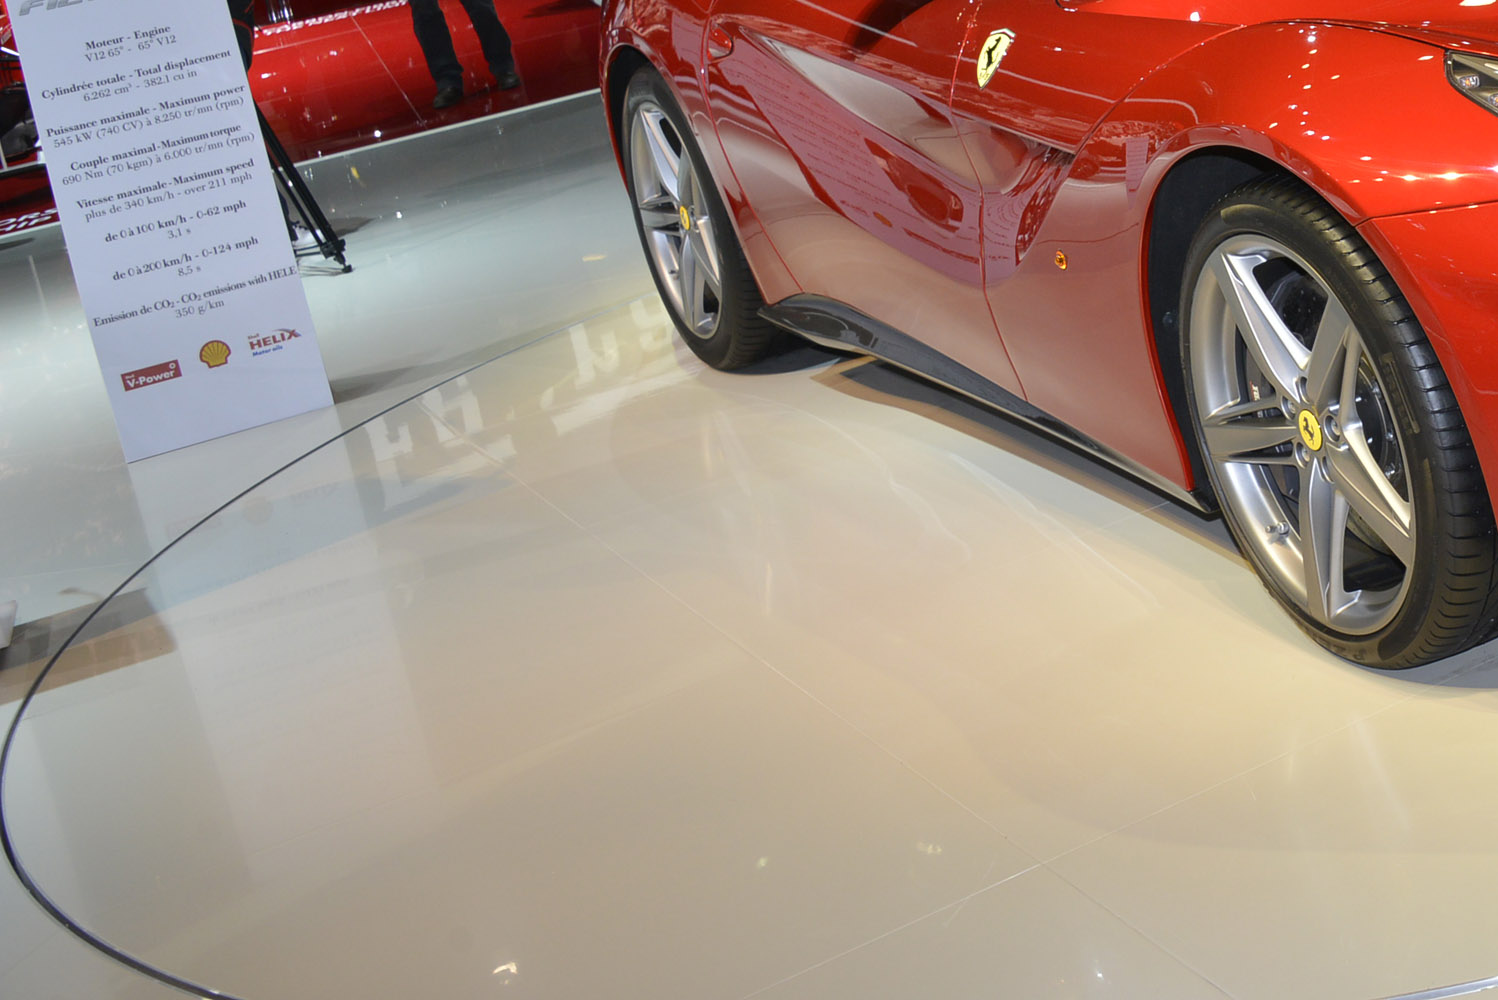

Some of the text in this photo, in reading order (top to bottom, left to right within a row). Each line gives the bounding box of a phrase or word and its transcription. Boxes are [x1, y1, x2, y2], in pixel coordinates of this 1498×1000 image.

[84, 50, 106, 62] V12
[156, 34, 176, 46] V12
[85, 36, 124, 50] Moteur
[134, 26, 170, 39] Engine
[42, 80, 93, 100] Cylindrée
[96, 72, 125, 87] totale
[134, 63, 161, 77] Total
[164, 49, 231, 71] displacement
[173, 72, 184, 81] cu
[187, 69, 197, 78] in
[46, 120, 97, 137] Puissance
[100, 106, 150, 125] maximale
[159, 93, 210, 111] Maximum
[213, 84, 245, 100] power
[54, 135, 73, 148] 545
[75, 130, 92, 143] kW
[96, 124, 120, 139] (740
[122, 119, 143, 131] CV)
[154, 110, 182, 124] 8.250
[184, 104, 213, 117] tr/mn
[215, 95, 244, 111] (rpm)
[62, 173, 82, 185] 690
[84, 167, 104, 180] Nm
[106, 162, 123, 176] (70
[126, 156, 153, 171] kgm)
[164, 146, 192, 160] 6.000
[195, 141, 223, 153] tr/mn
[226, 131, 254, 147] (rpm)
[70, 155, 109, 171] Couple
[112, 142, 156, 161] maximal
[161, 132, 209, 149] Maximum
[210, 124, 241, 137] torque
[76, 195, 114, 209] Vitesse
[117, 180, 167, 200] maximale
[173, 168, 223, 185] Maximum
[226, 157, 254, 174] speed
[85, 208, 106, 223] plus
[109, 203, 122, 214] de
[124, 197, 144, 210] 340
[146, 190, 174, 204] km/h
[184, 184, 206, 195] over
[208, 176, 226, 189] 211
[230, 171, 252, 184] mph
[105, 232, 118, 242] de
[136, 222, 155, 234] 100
[157, 214, 187, 229] km/h
[223, 199, 246, 213] mph
[113, 270, 126, 280] de
[142, 260, 162, 273] 200
[162, 252, 192, 268] km/h
[235, 235, 258, 249] mph
[93, 310, 138, 327] Emission
[140, 304, 152, 315] de
[203, 281, 246, 298] emissions
[248, 273, 267, 286] with
[268, 265, 297, 280] HELE
[175, 299, 224, 318] 350 g/km
[248, 329, 300, 351] HELIX
[127, 370, 175, 388] V-Power
